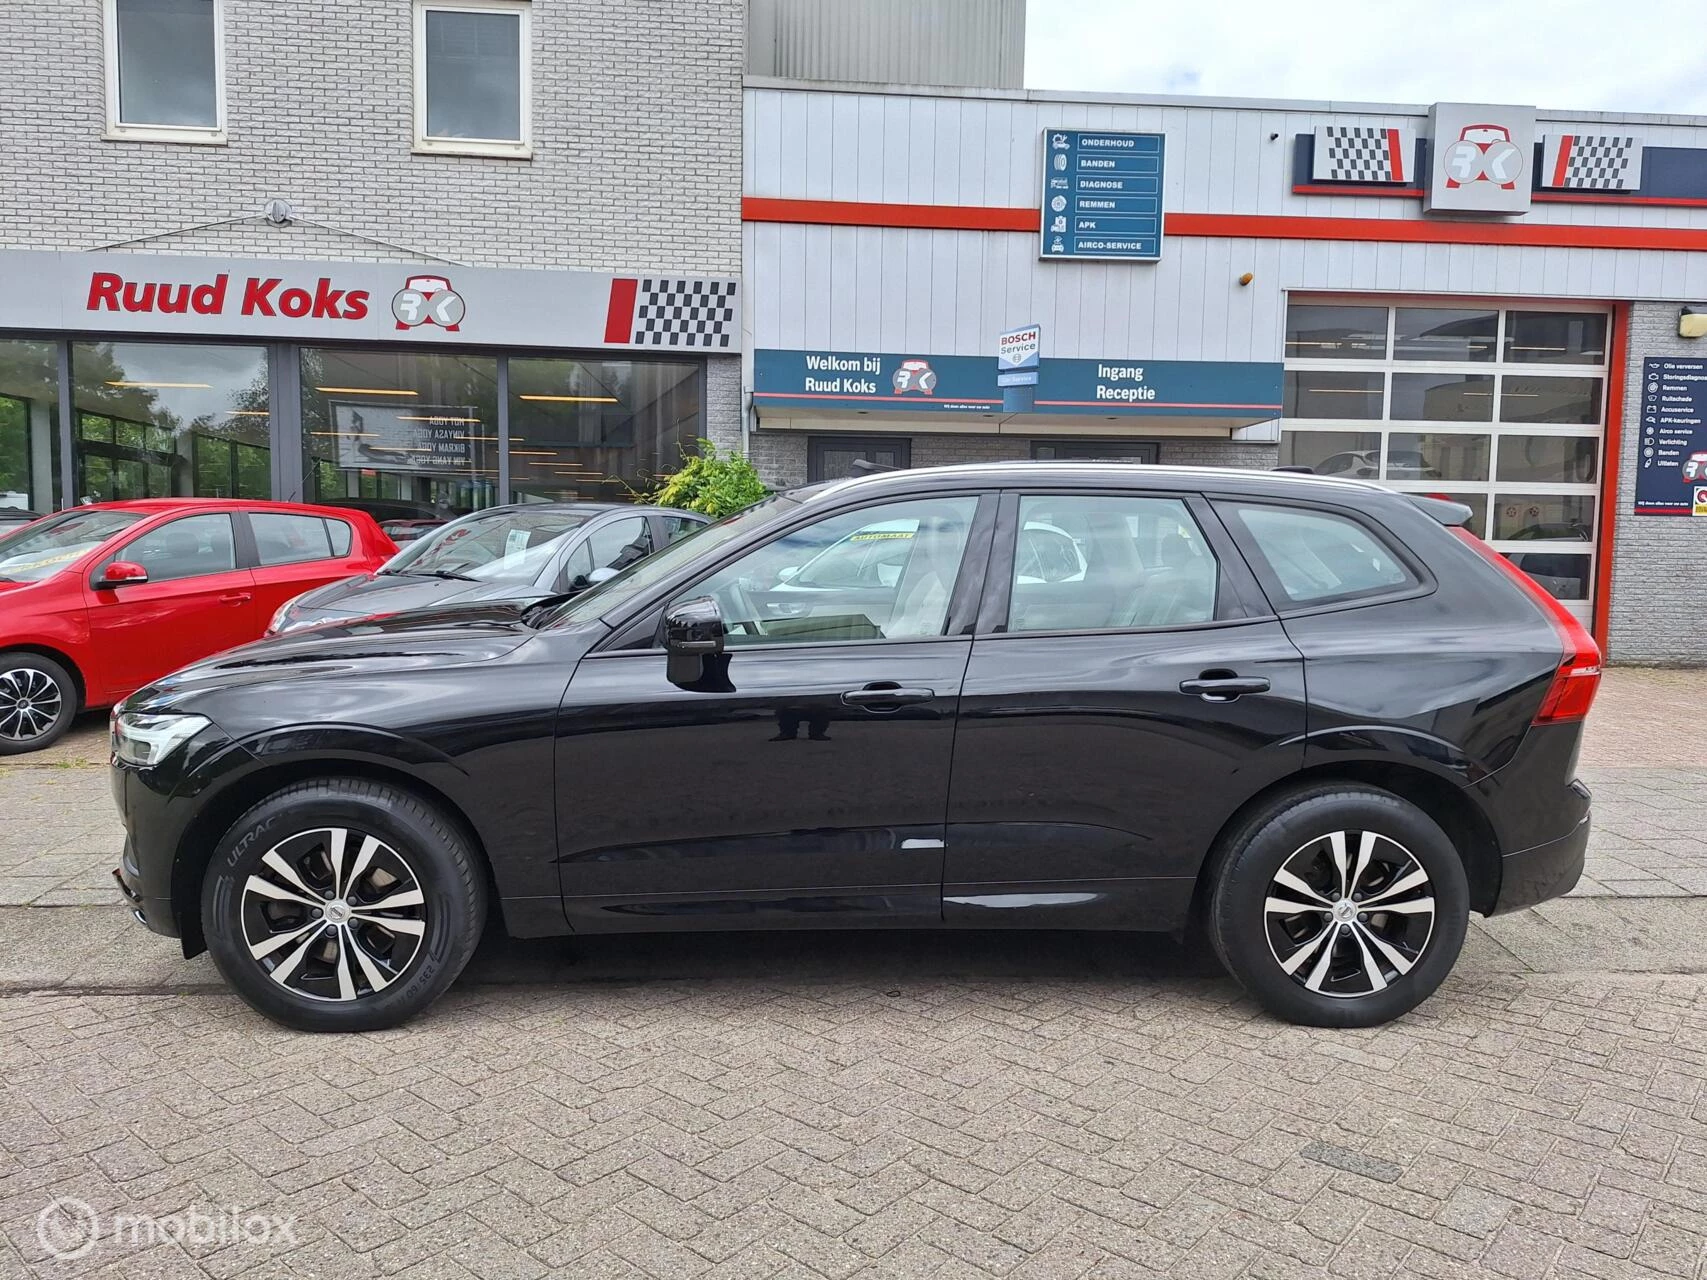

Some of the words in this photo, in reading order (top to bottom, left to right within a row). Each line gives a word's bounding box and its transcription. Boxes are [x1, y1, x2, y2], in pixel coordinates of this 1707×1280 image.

[1081, 138, 1135, 147] ONDERHOUD
[1080, 159, 1116, 168] BANDEN
[1079, 180, 1123, 189] DIAGNOSE
[1079, 200, 1116, 209] REMMEN
[1078, 221, 1096, 229] APK
[1077, 241, 1142, 250] AIRCO-SERVICE
[86, 272, 229, 315] Ruud
[240, 277, 370, 320] Koks
[1001, 331, 1037, 345] BOSCH
[1000, 343, 1036, 355] Service
[806, 355, 860, 372] Welkom
[863, 357, 881, 375] bij
[1098, 363, 1144, 381] Ingang
[805, 377, 840, 392] Ruud
[843, 378, 876, 394] Koks
[1096, 385, 1156, 402] Receptie
